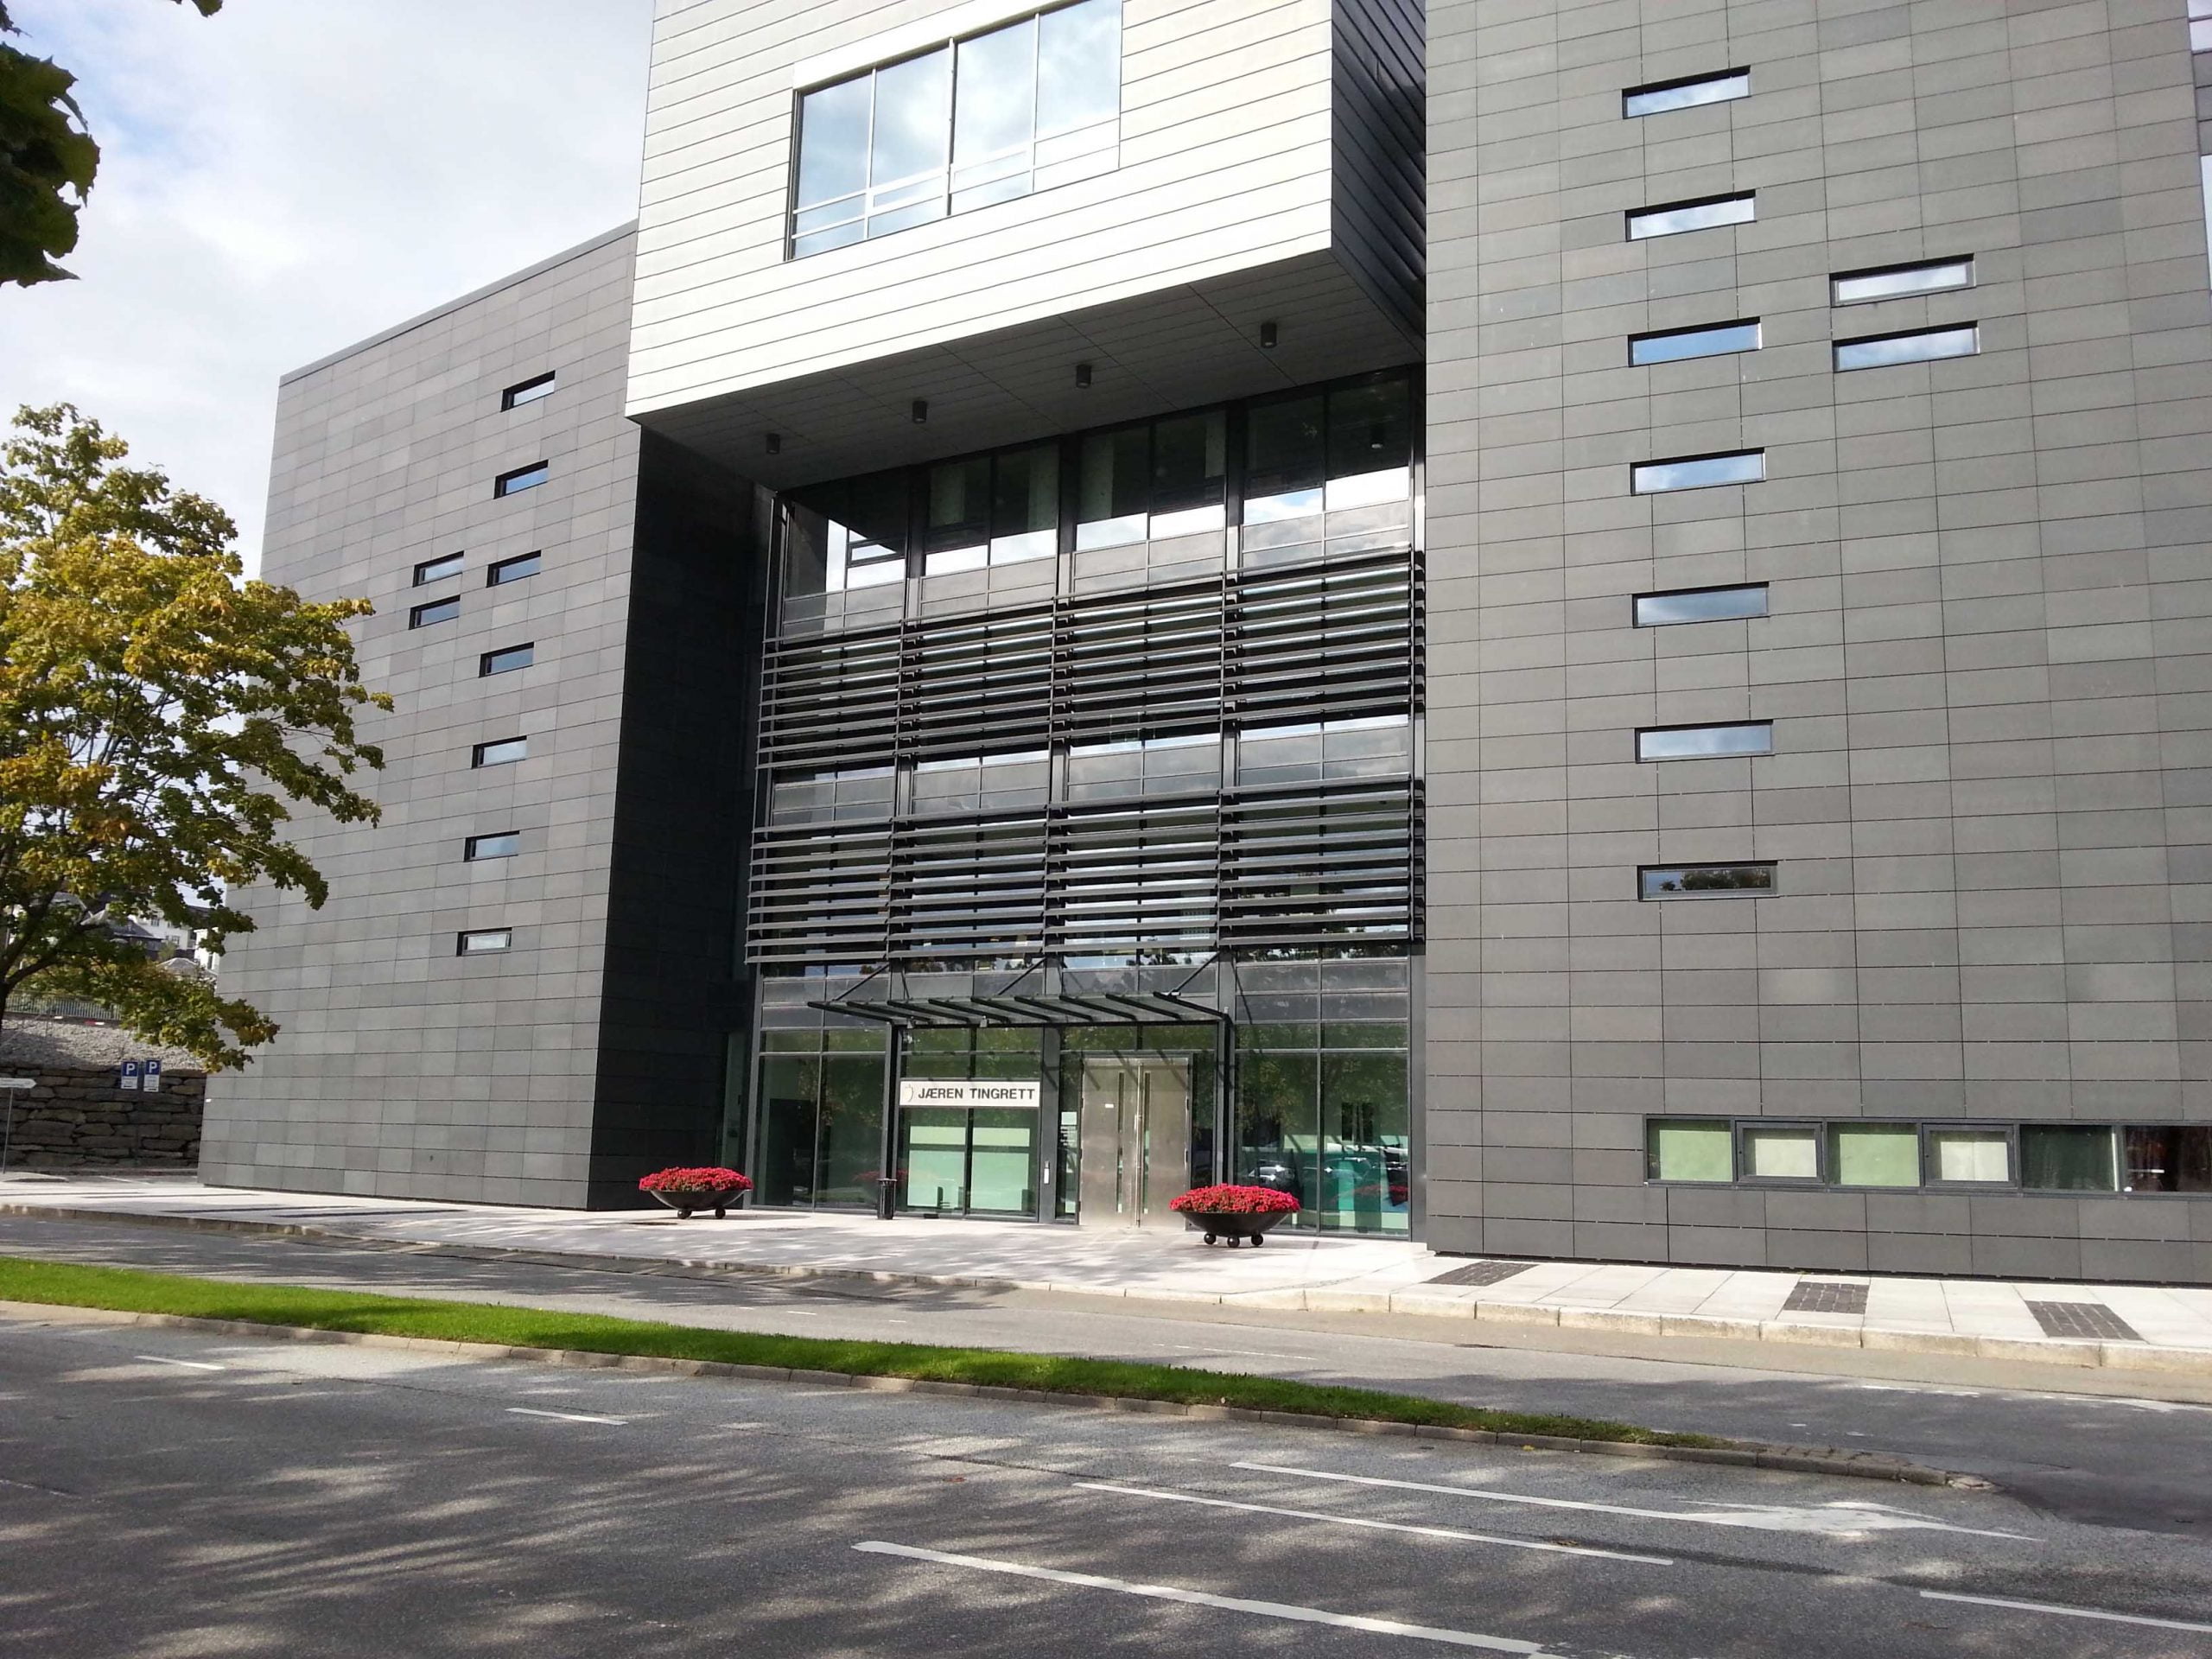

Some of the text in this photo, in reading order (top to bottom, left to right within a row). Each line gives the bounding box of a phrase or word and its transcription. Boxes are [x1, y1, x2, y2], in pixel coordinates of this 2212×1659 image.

[126, 1063, 135, 1075] P
[149, 1061, 157, 1073] P
[918, 1088, 1035, 1100] JÆREN TINGRETT
